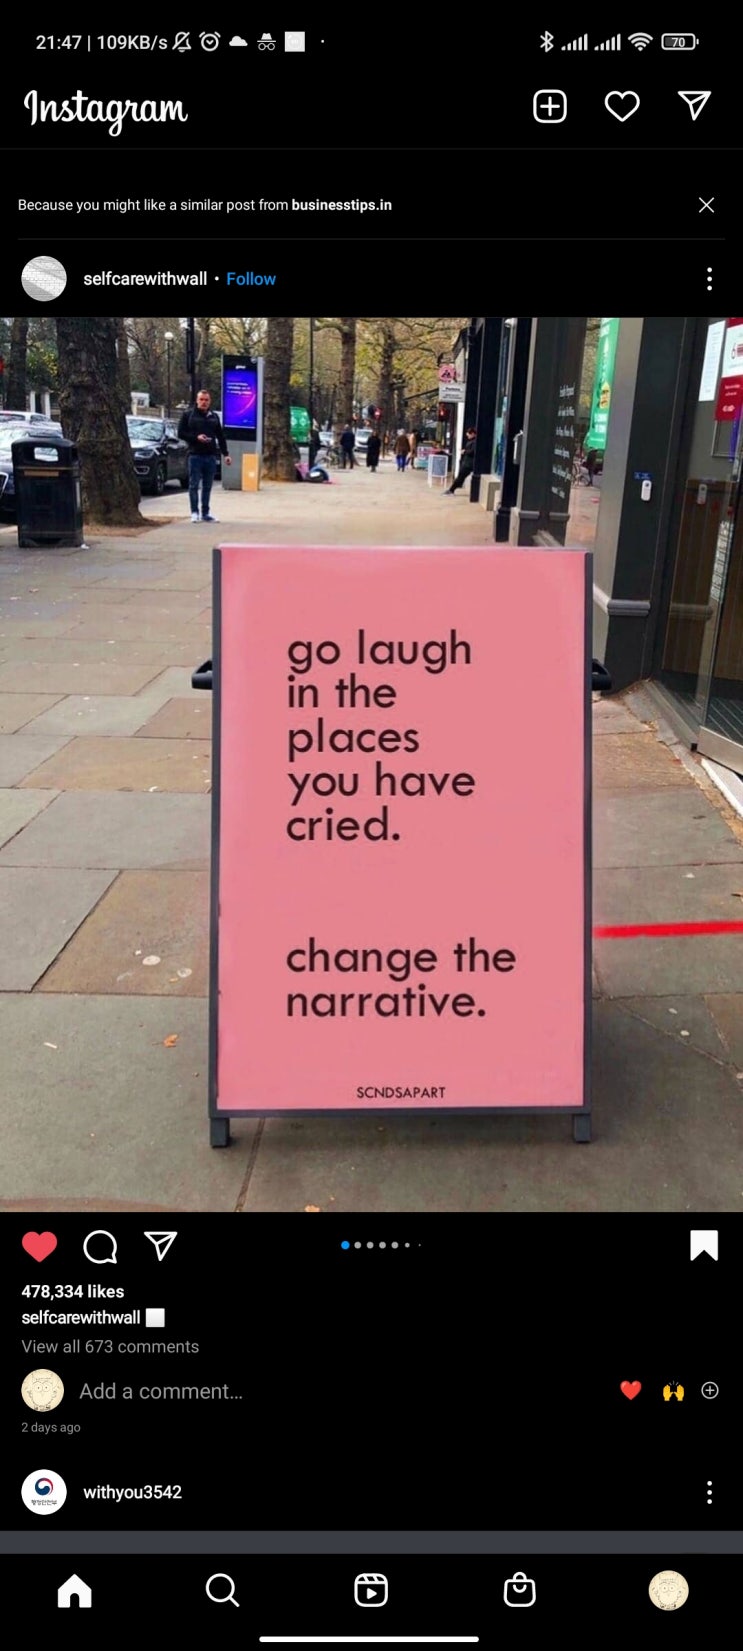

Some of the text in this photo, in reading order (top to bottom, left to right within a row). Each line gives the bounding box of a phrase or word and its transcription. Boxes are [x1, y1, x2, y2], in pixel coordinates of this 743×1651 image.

[35, 34, 83, 50] 21:47
[97, 34, 168, 51] 109KB/s
[671, 37, 686, 48] 70
[23, 89, 189, 138] Instagram
[18, 198, 393, 214] Because you might like a similar post from businesstips.in
[83, 270, 277, 286] selfcarewithwall Follow
[288, 629, 472, 675] go laugh
[287, 673, 397, 709] in the
[288, 717, 420, 763] places
[288, 761, 476, 806] you have
[286, 805, 401, 842] cried.
[286, 937, 517, 982] change the
[286, 985, 486, 1018] narrative.
[356, 1086, 446, 1099] SCNDSAPART
[21, 1283, 125, 1301] 478,334 likes
[21, 1309, 141, 1325] selfcarewithwall
[21, 1338, 200, 1354] View all 673 comments
[79, 1381, 116, 1400] Add
[122, 1386, 133, 1400] a
[21, 1421, 81, 1435] 2 days ago
[82, 1483, 183, 1503] withyou3542
